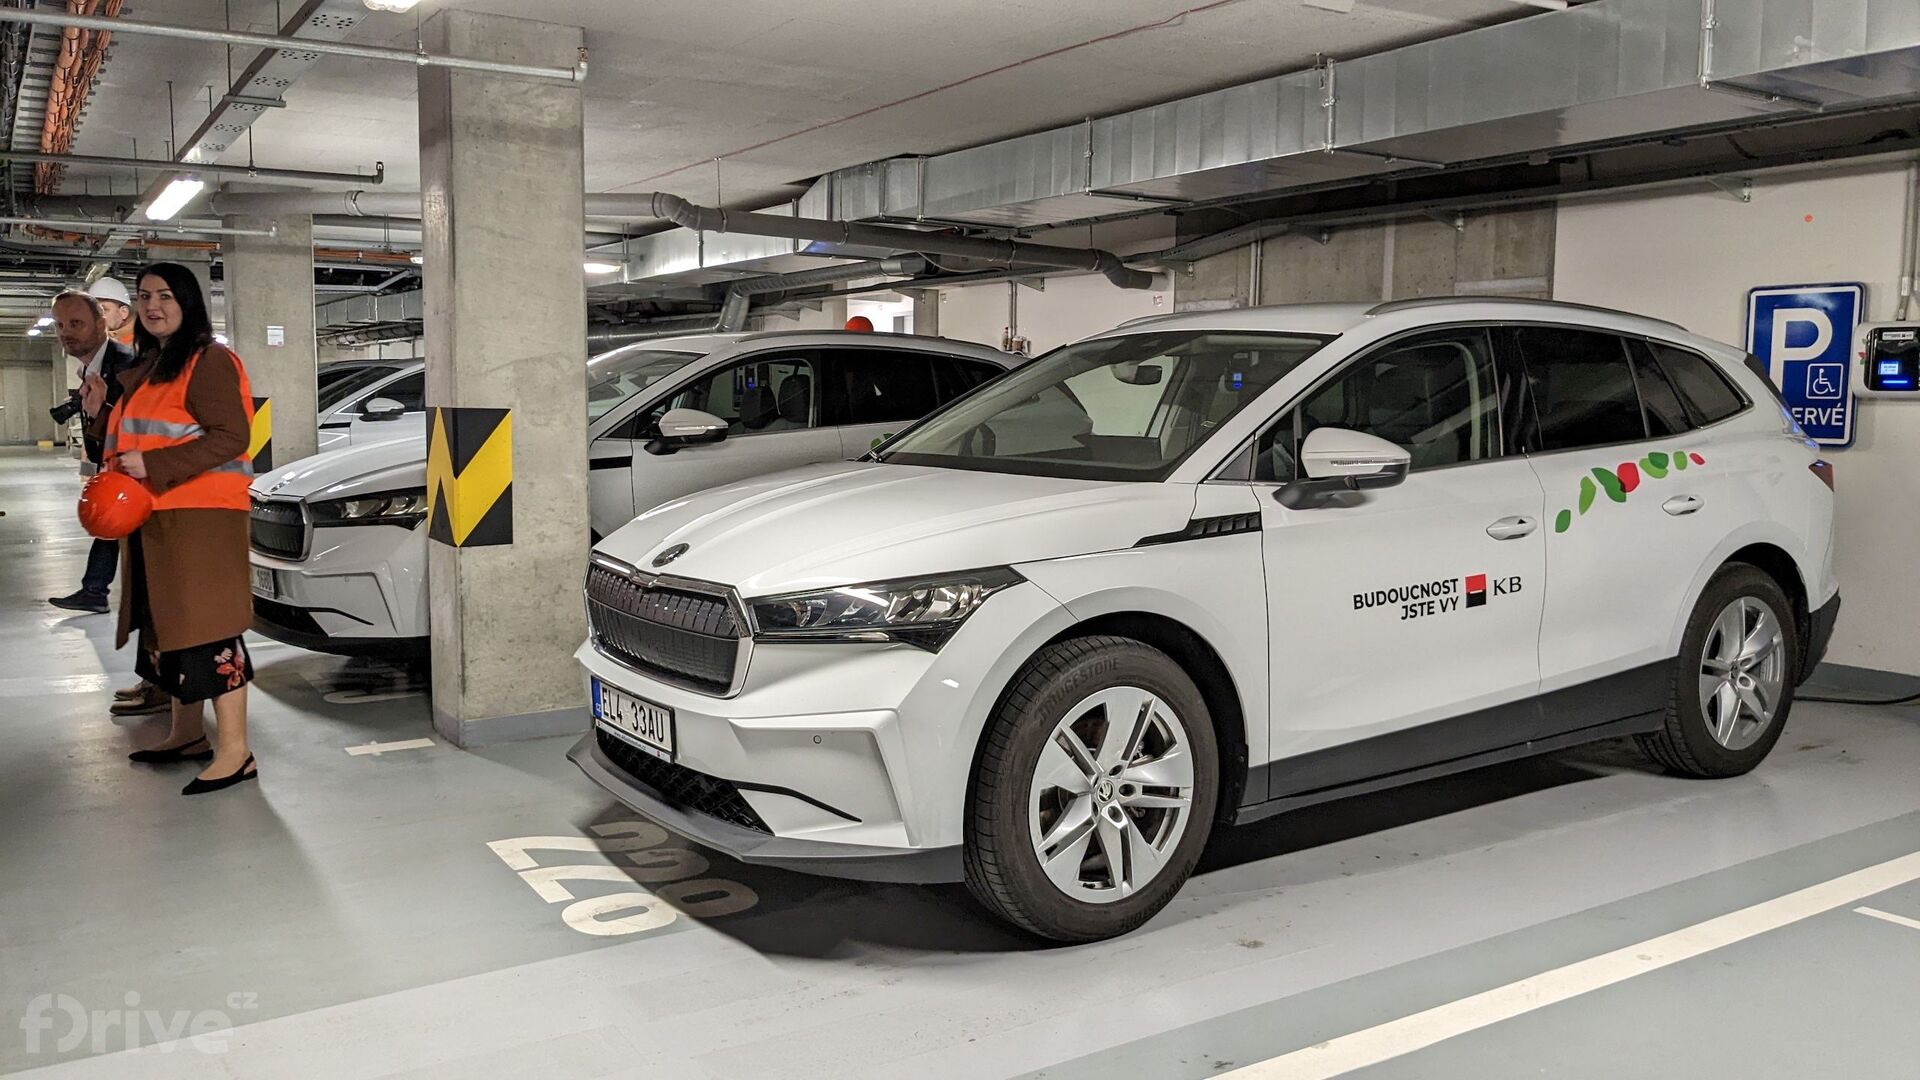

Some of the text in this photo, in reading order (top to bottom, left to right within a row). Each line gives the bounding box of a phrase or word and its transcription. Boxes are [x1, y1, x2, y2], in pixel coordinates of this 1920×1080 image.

[1770, 307, 1833, 393] P
[1792, 402, 1845, 426] ERVÉ
[1353, 578, 1458, 610] BUDOUCNOST
[1493, 576, 1522, 596] KB
[1401, 596, 1459, 620] JSTE VY
[602, 687, 623, 725] EL4
[631, 702, 665, 743] 33AU
